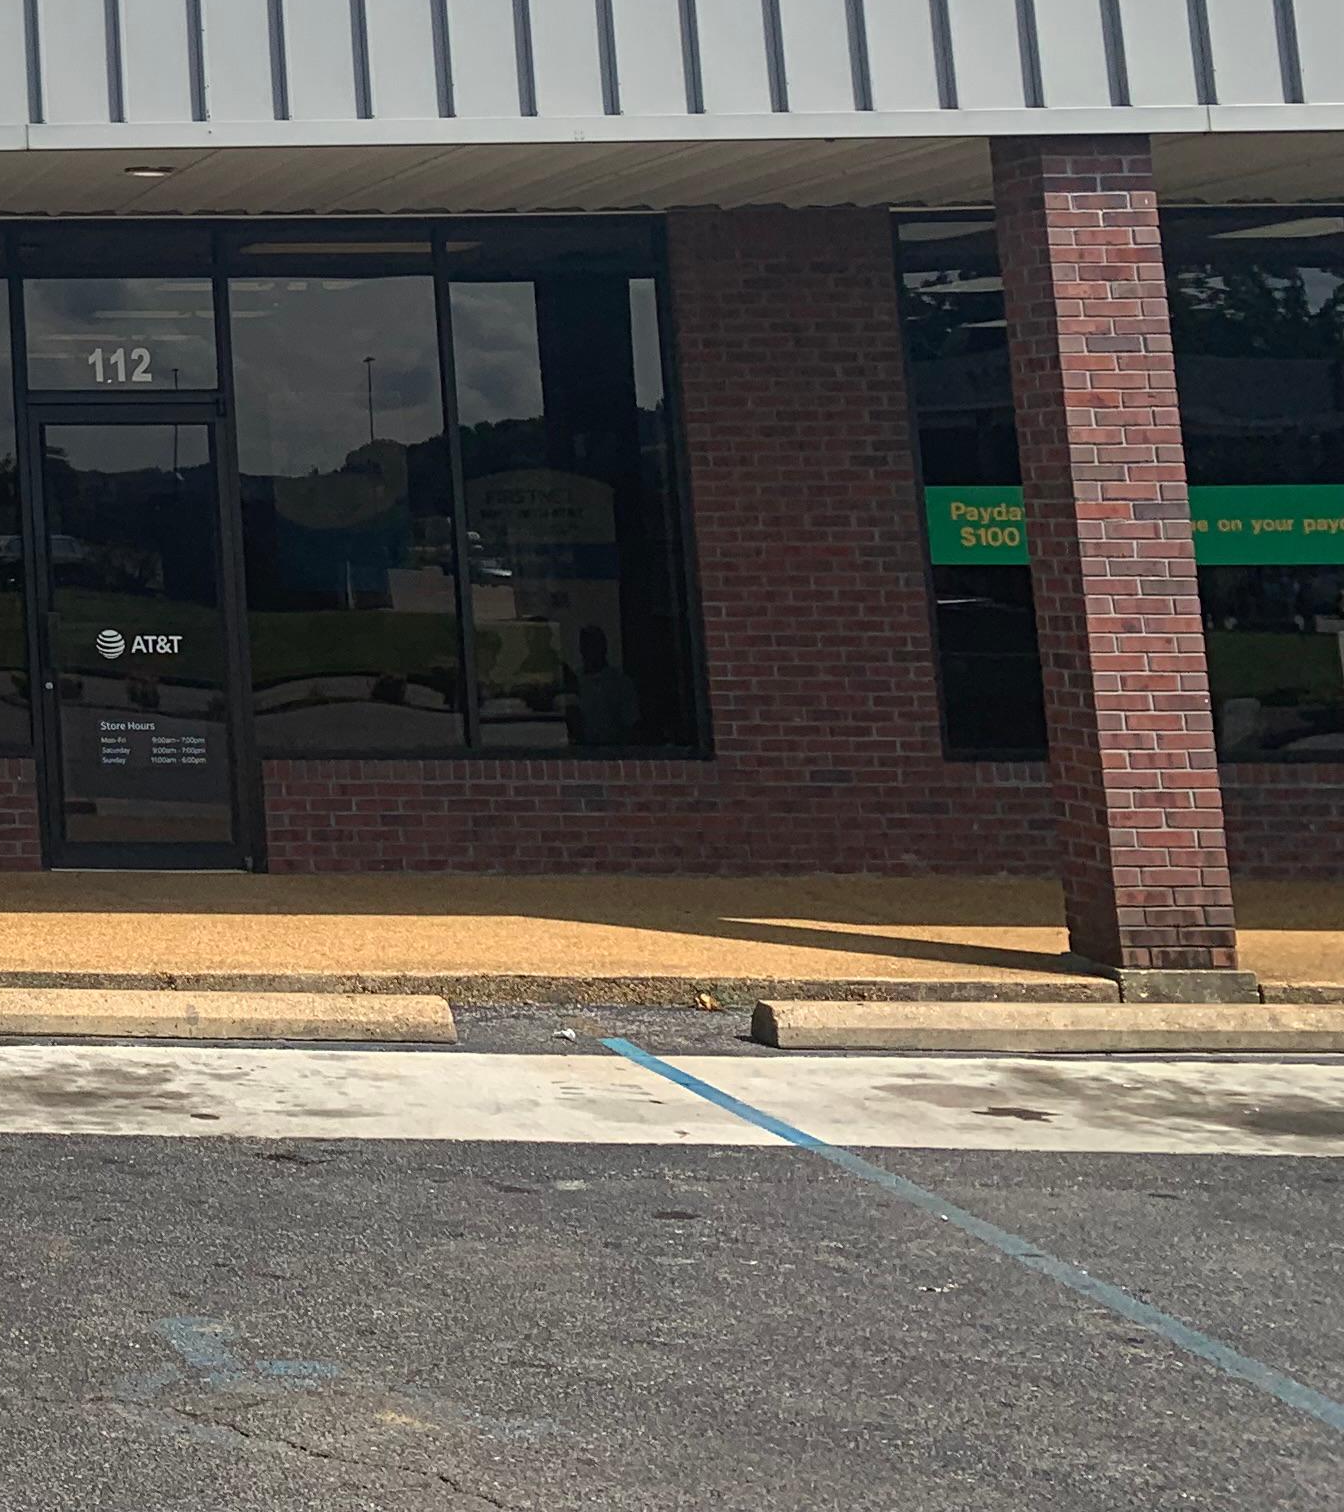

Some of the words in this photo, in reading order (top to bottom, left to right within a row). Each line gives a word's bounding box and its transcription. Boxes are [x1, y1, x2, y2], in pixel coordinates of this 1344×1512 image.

[88, 348, 152, 382] 112
[950, 501, 1025, 525] Payda
[1217, 519, 1242, 531] on
[1251, 519, 1294, 535] your
[960, 527, 1020, 547] $100
[131, 635, 183, 654] AT&T
[100, 721, 126, 731] Store
[127, 721, 155, 731] Hours
